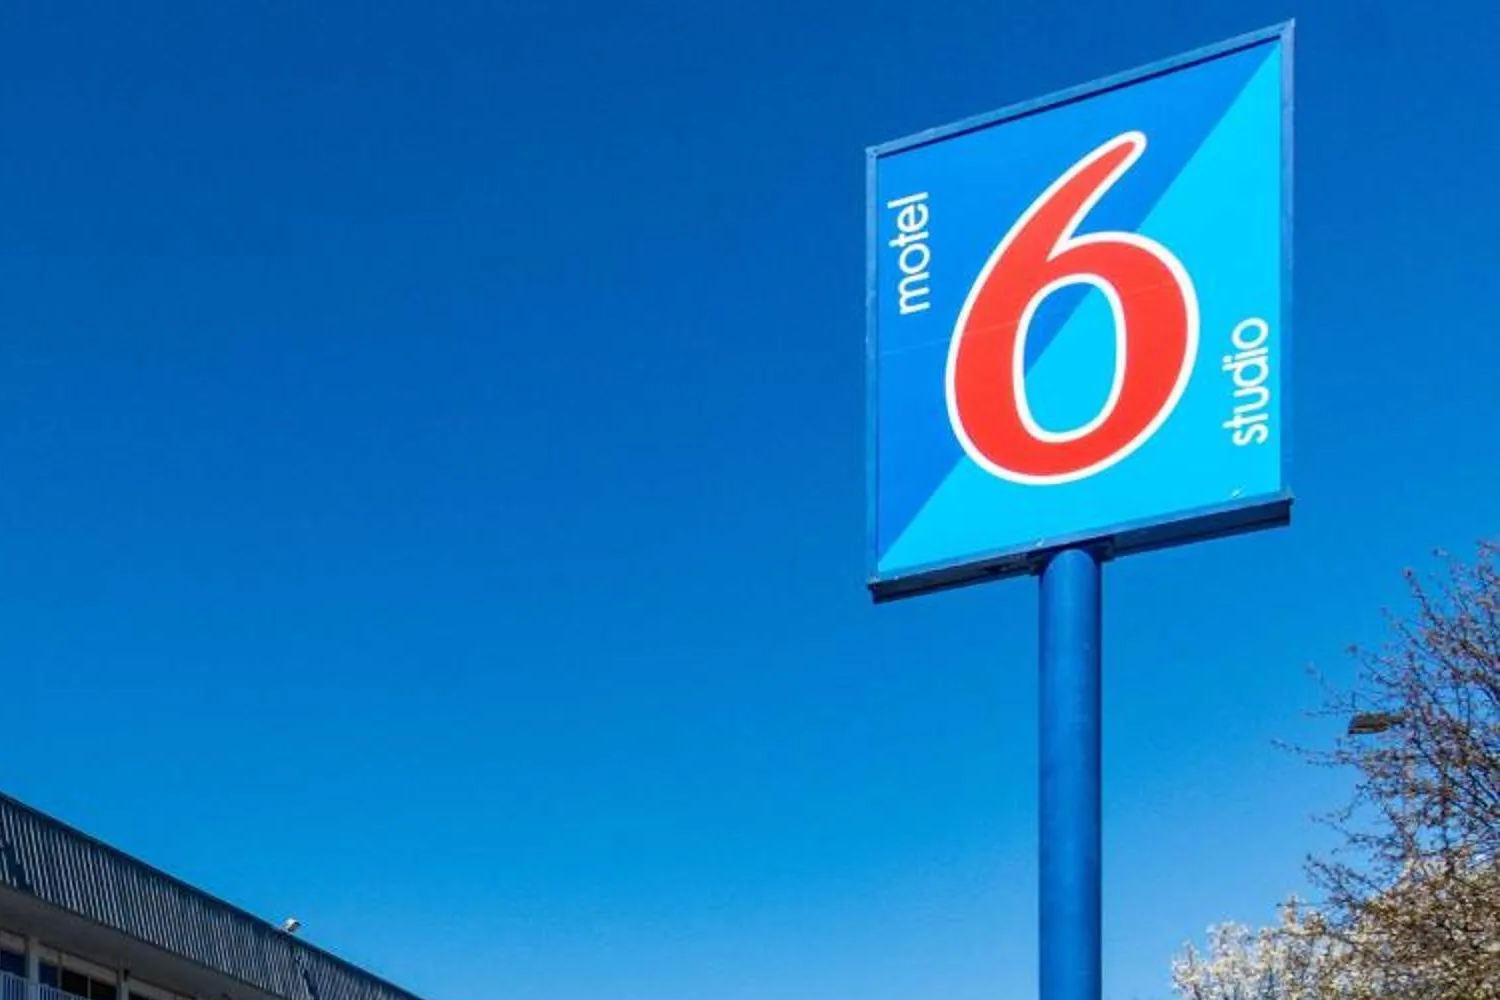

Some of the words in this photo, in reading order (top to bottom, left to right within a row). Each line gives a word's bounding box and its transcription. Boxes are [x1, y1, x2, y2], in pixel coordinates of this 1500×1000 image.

[887, 191, 931, 315] motel
[945, 130, 1201, 485] 6
[1222, 317, 1269, 445] studio
